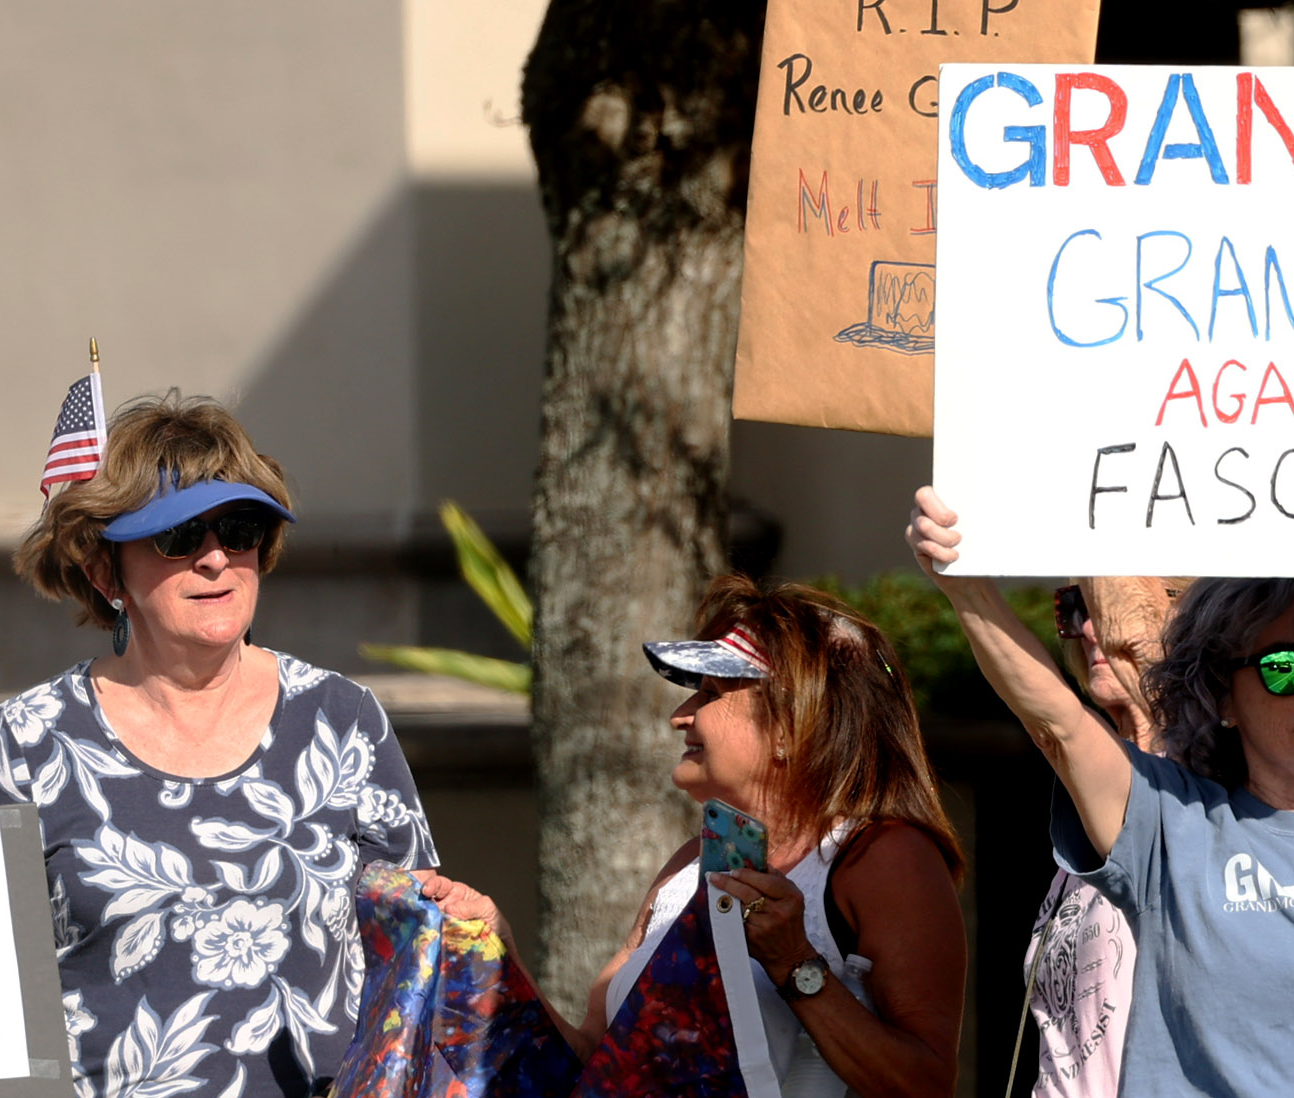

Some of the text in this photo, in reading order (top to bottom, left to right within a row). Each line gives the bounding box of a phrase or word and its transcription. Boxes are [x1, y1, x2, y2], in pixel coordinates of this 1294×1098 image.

[777, 53, 884, 116] Renee
[798, 168, 882, 237] Melt
[1080, 998, 1116, 1066] RESIST
